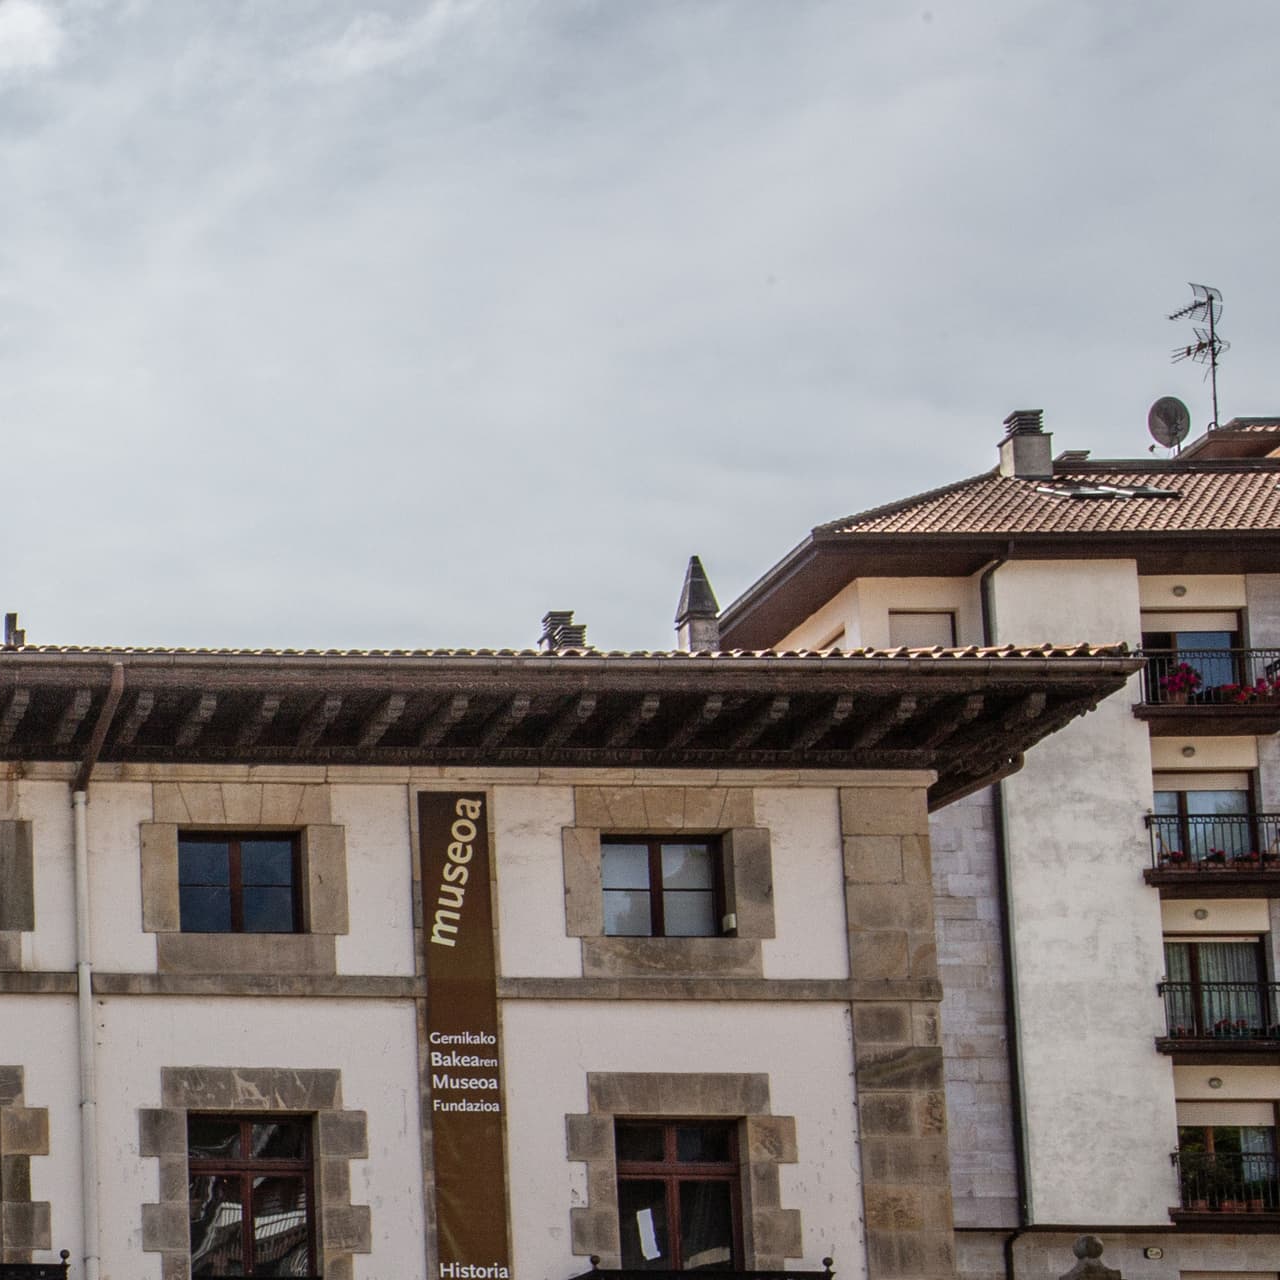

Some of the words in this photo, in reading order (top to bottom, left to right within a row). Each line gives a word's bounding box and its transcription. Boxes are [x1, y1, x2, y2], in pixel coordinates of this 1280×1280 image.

[430, 798, 482, 947] museoa
[430, 1031, 496, 1044] Gernikako
[431, 1050, 498, 1067] Bakearen
[432, 1074, 498, 1089] Museoa
[433, 1098, 500, 1112] Fundazioa
[439, 1262, 509, 1278] Historia
